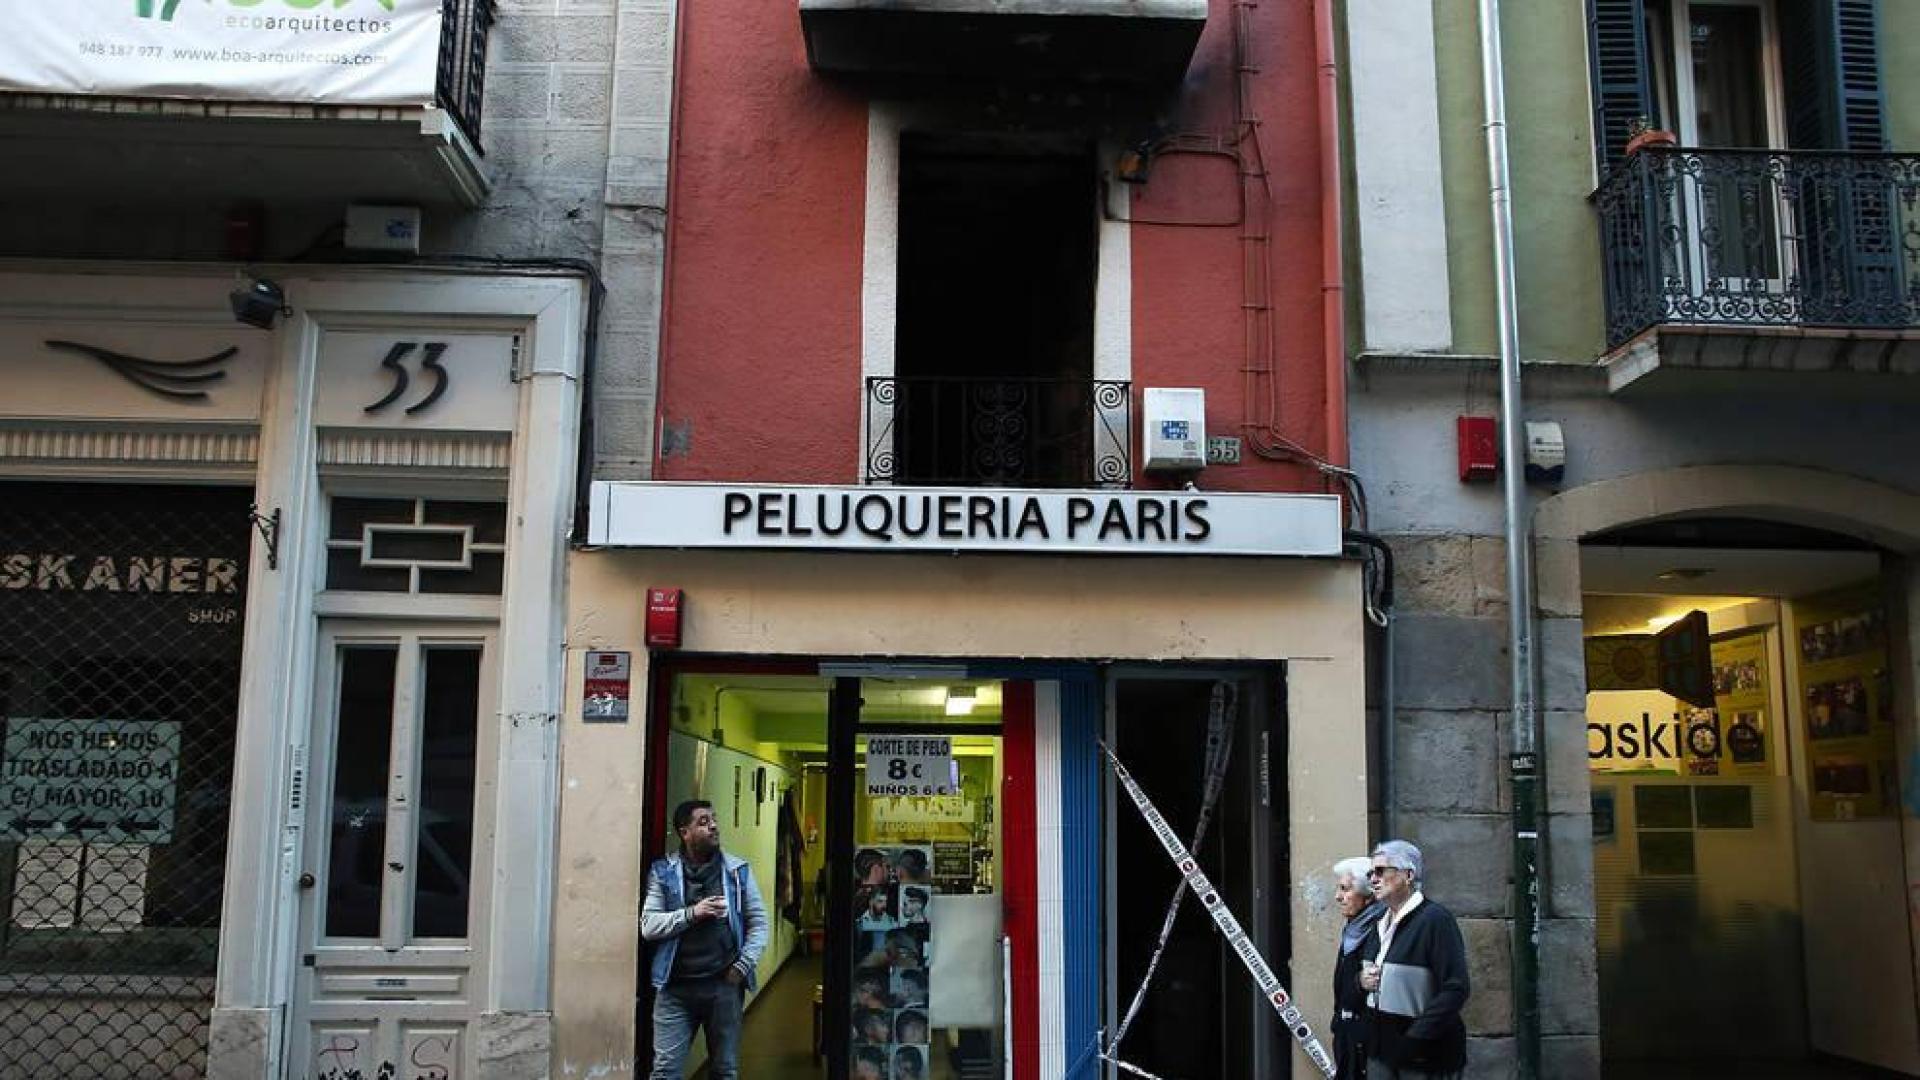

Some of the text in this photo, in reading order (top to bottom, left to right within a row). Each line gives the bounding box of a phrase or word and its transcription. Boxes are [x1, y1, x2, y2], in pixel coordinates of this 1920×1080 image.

[224, 13, 391, 34] ecoarquitectos
[79, 41, 105, 56] 948
[137, 43, 162, 58] 977
[363, 342, 449, 416] 53
[1208, 439, 1239, 462] 55
[723, 492, 1212, 542] PELUQUERIA PARIS
[0, 554, 239, 593] SKANER
[188, 607, 238, 624] SHOP
[30, 730, 159, 751] NOS HEMOS
[870, 738, 949, 756] CORTE DE PELO
[9, 760, 172, 780] TRASLADADO A
[888, 758, 907, 780] 8
[11, 783, 163, 810] C/ MAYOR, 10
[869, 783, 918, 796] NIÑOS
[923, 784, 933, 796] 6
